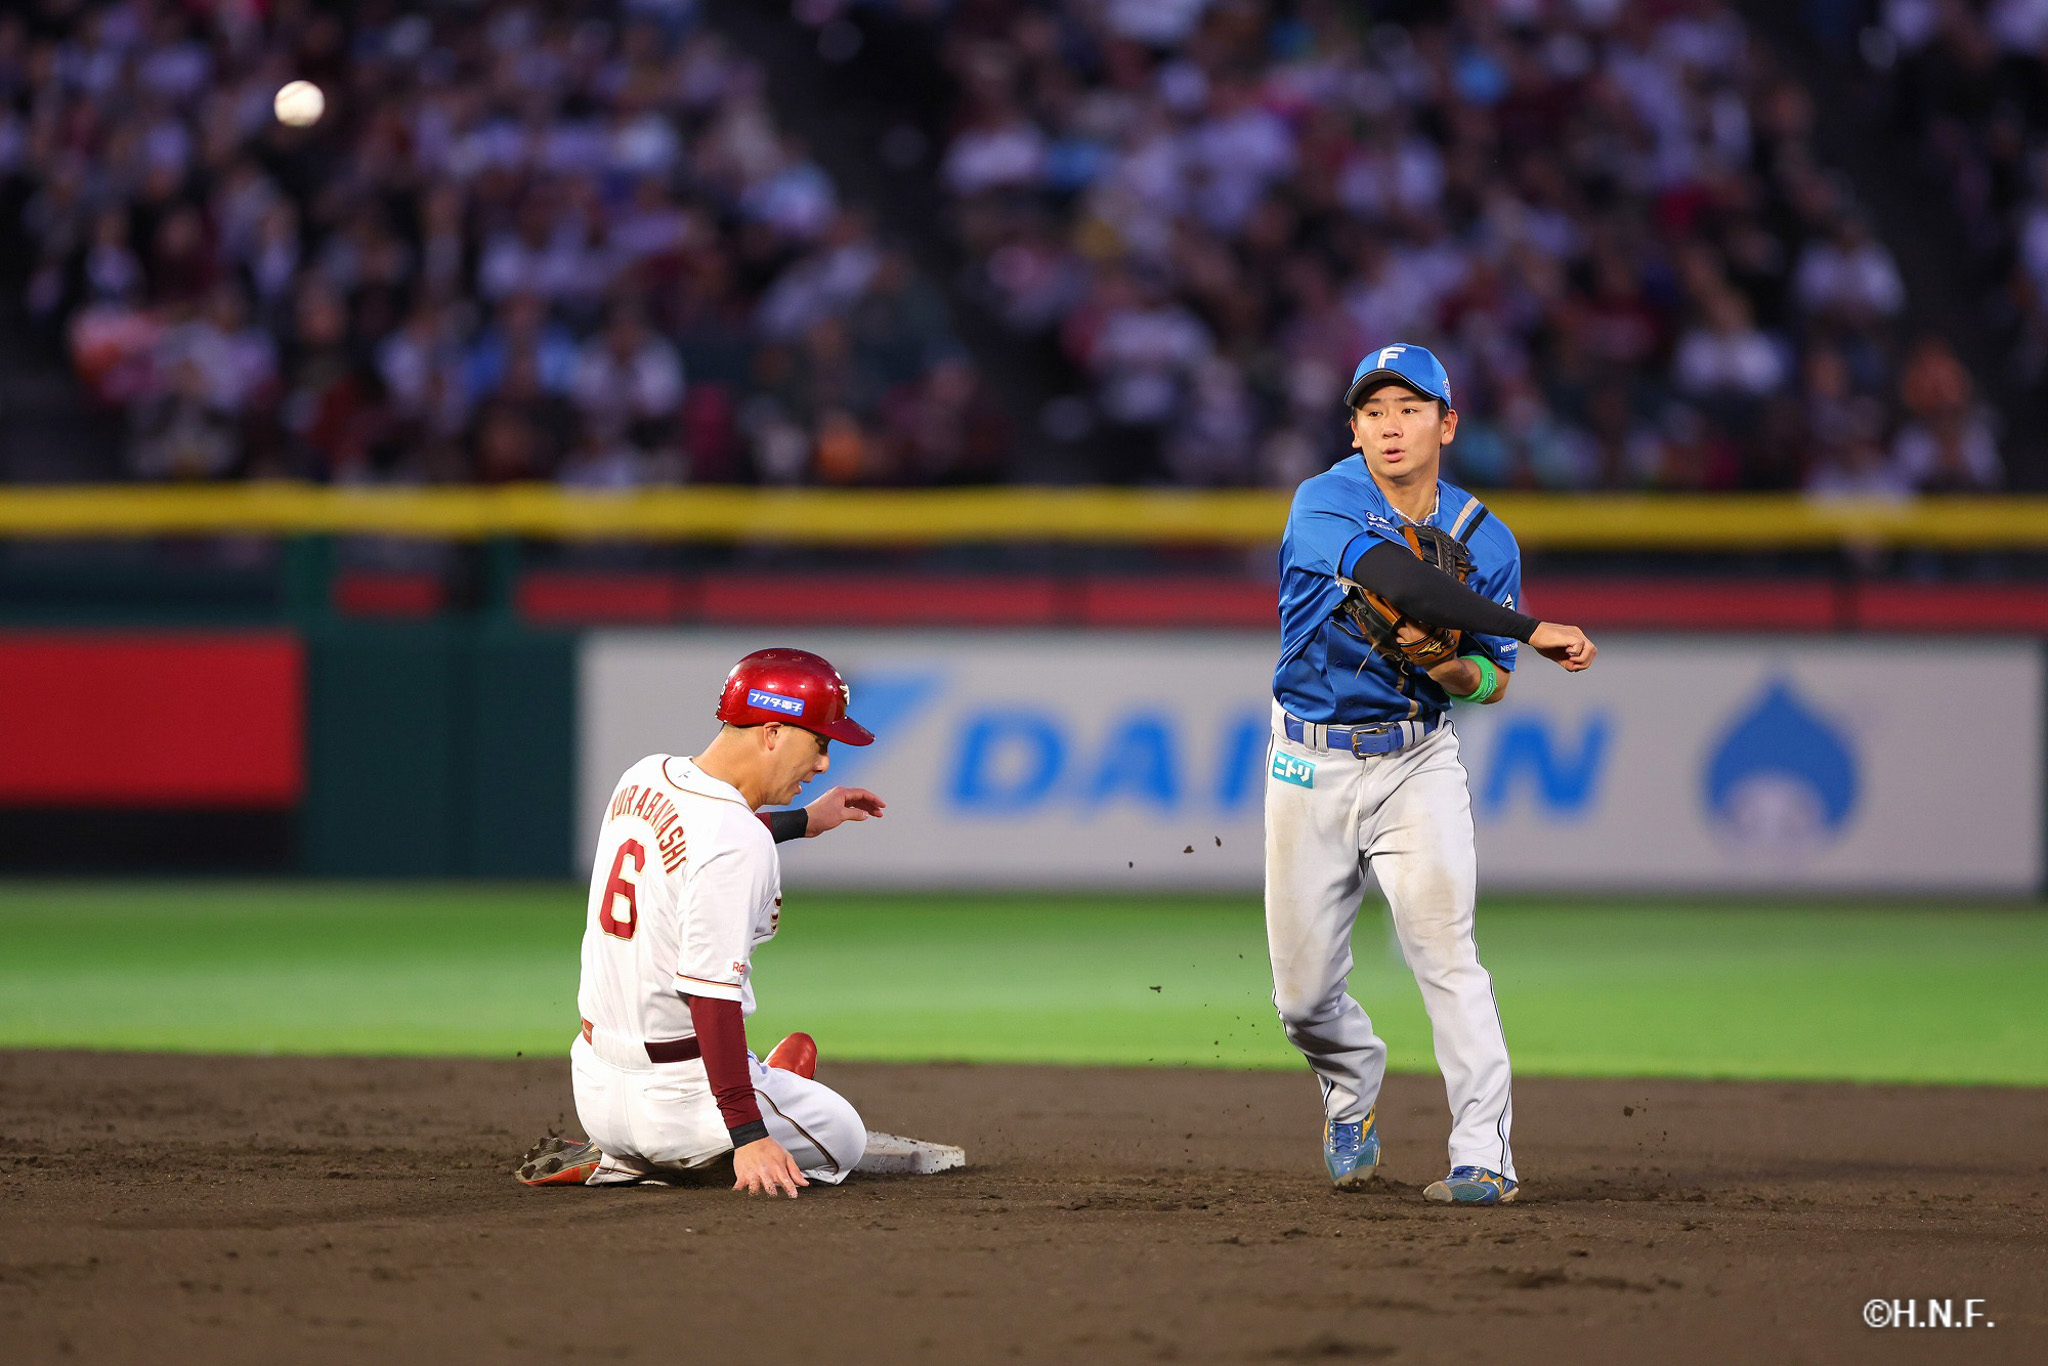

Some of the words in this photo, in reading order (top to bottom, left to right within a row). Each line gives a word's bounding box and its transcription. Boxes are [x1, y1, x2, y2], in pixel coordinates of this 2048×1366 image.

[1377, 346, 1407, 369] F
[947, 706, 1612, 816] DAIN
[1274, 756, 1311, 782] ニトリ
[599, 838, 646, 942] 6
